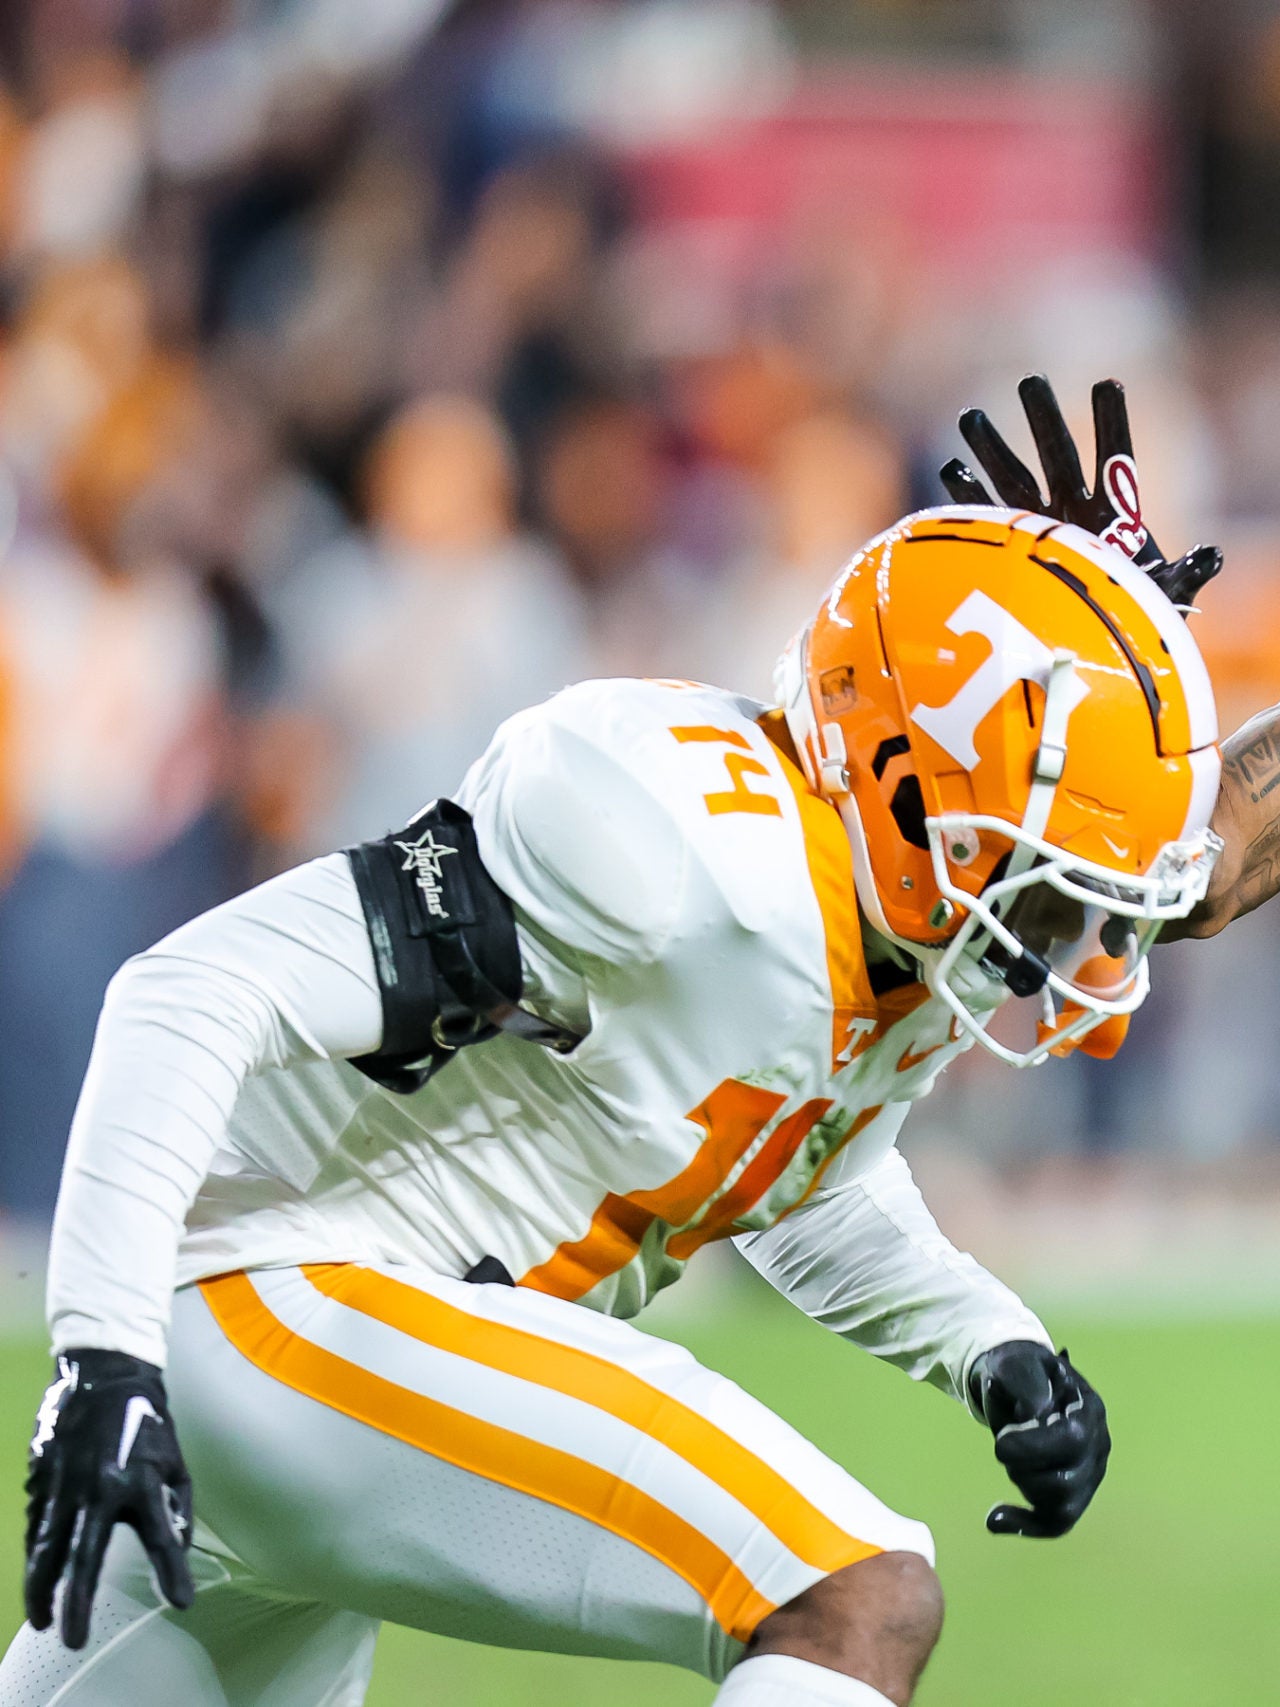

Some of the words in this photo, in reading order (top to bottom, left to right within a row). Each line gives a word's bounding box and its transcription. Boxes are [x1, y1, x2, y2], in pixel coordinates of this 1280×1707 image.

[910, 588, 1091, 772] T
[668, 723, 785, 820] 14
[836, 1016, 878, 1062] T
